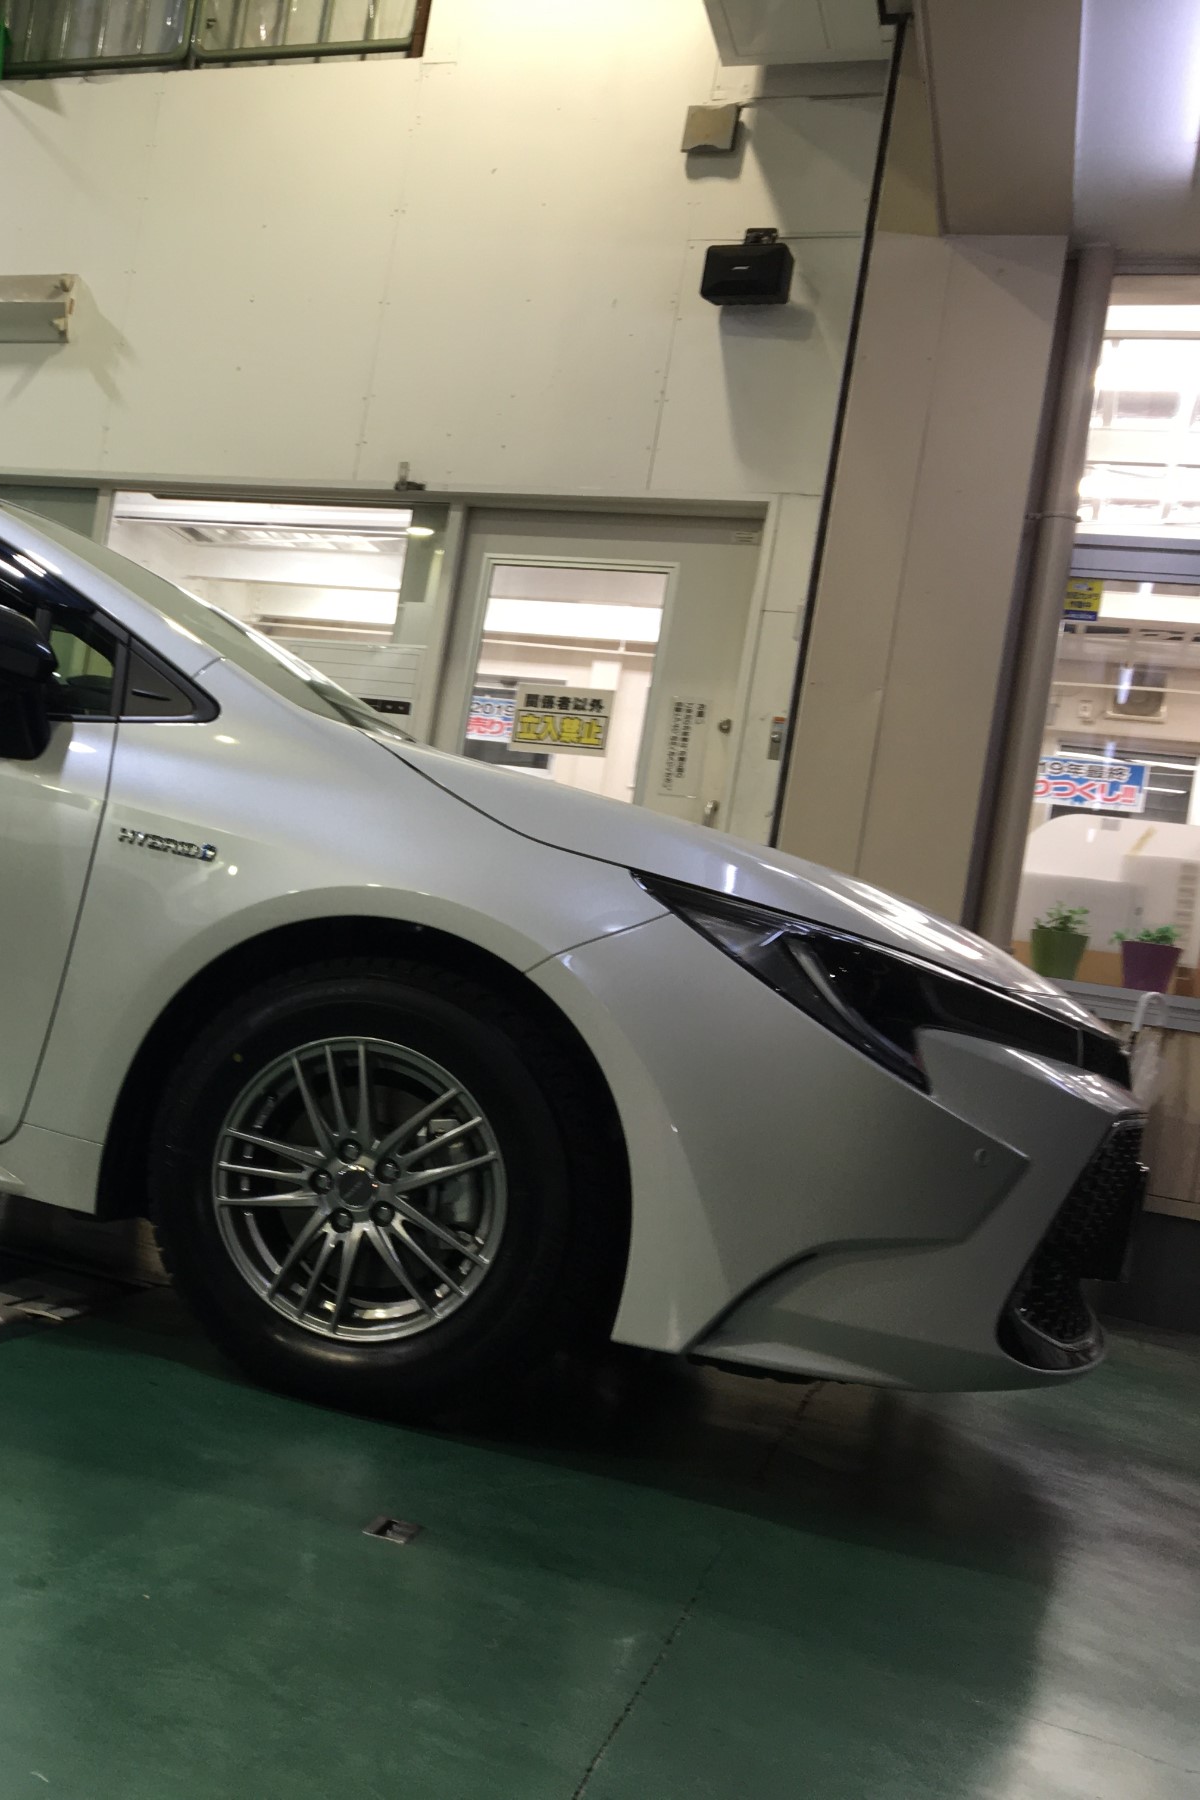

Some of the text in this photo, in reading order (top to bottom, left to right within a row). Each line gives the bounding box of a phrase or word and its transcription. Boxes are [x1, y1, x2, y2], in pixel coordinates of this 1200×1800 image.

[524, 693, 605, 713] 関係者以外
[468, 716, 514, 737] 売り
[516, 713, 603, 746] 立入禁止
